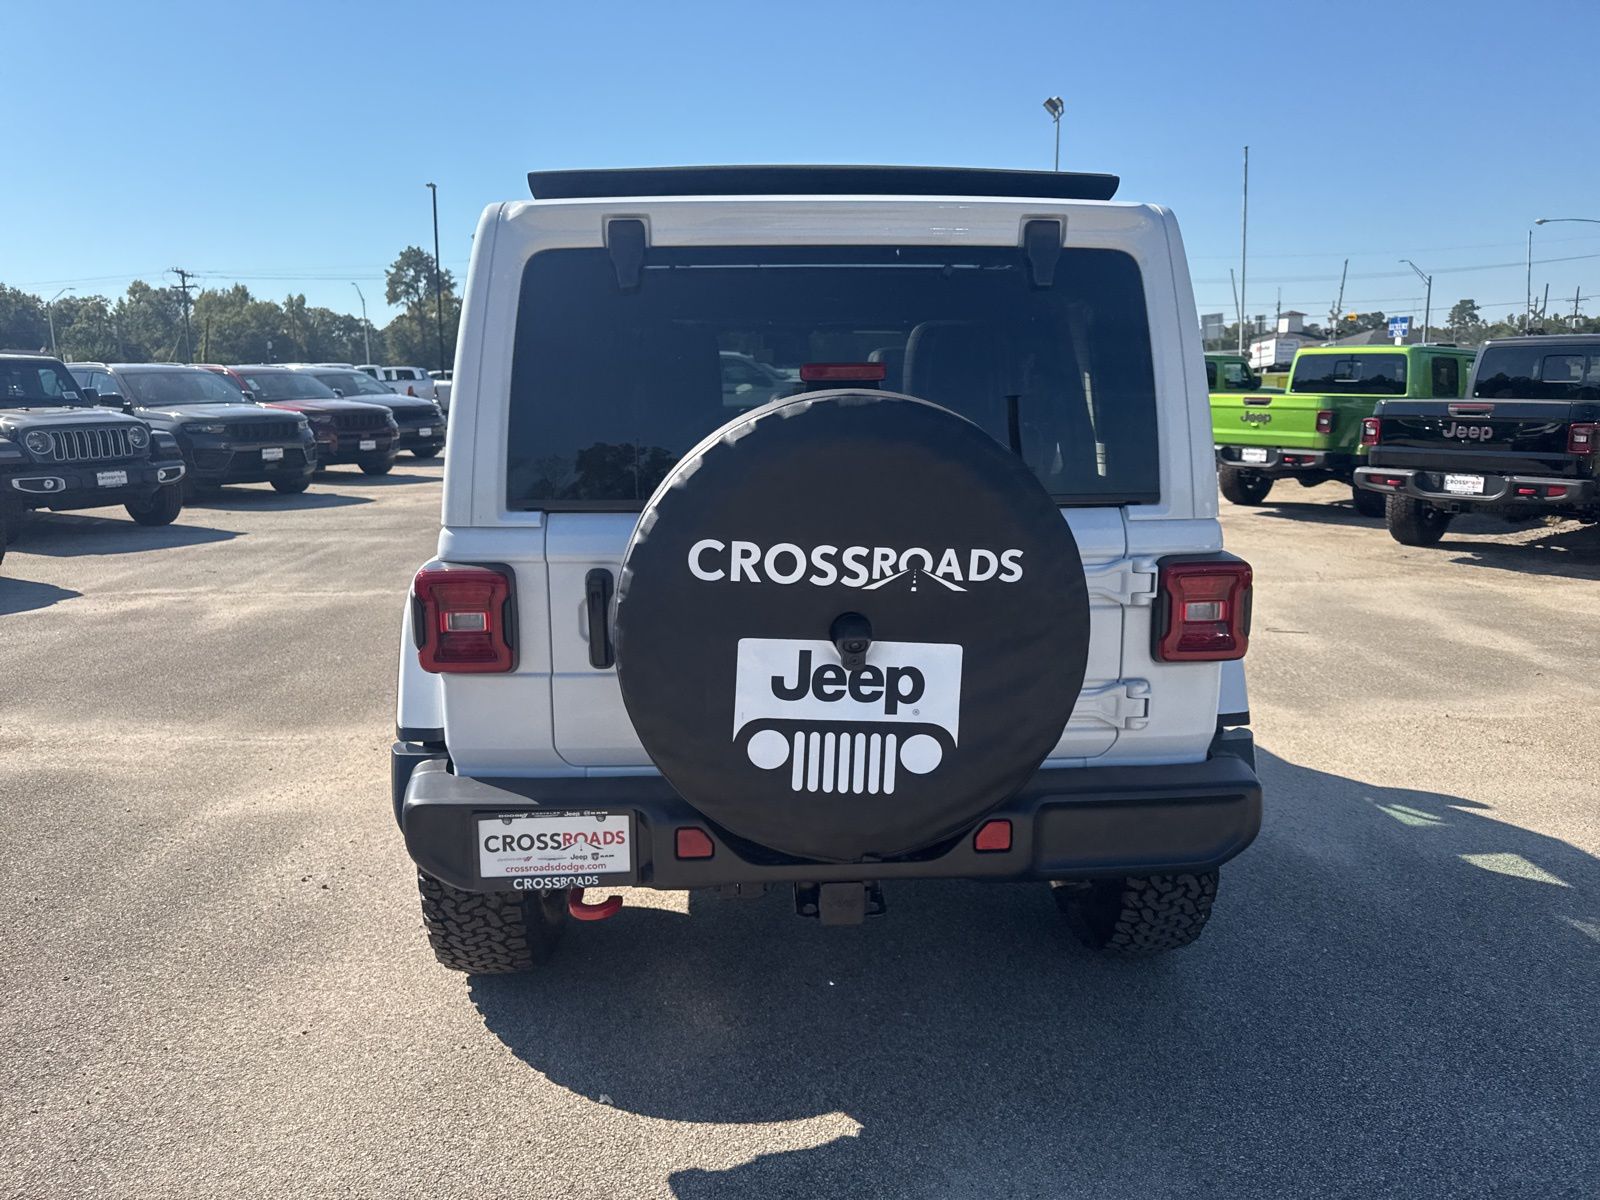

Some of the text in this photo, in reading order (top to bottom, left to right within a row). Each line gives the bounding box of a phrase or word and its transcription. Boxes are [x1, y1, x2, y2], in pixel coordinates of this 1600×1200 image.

[1240, 410, 1272, 425] Jeep
[1442, 422, 1494, 442] Jeep
[687, 538, 1024, 588] CROSSROADS
[770, 649, 926, 715] Jeep
[484, 830, 626, 853] CROSSROADS
[505, 862, 607, 873] crossroadsdodge.com
[513, 875, 599, 891] CROSSROADS
